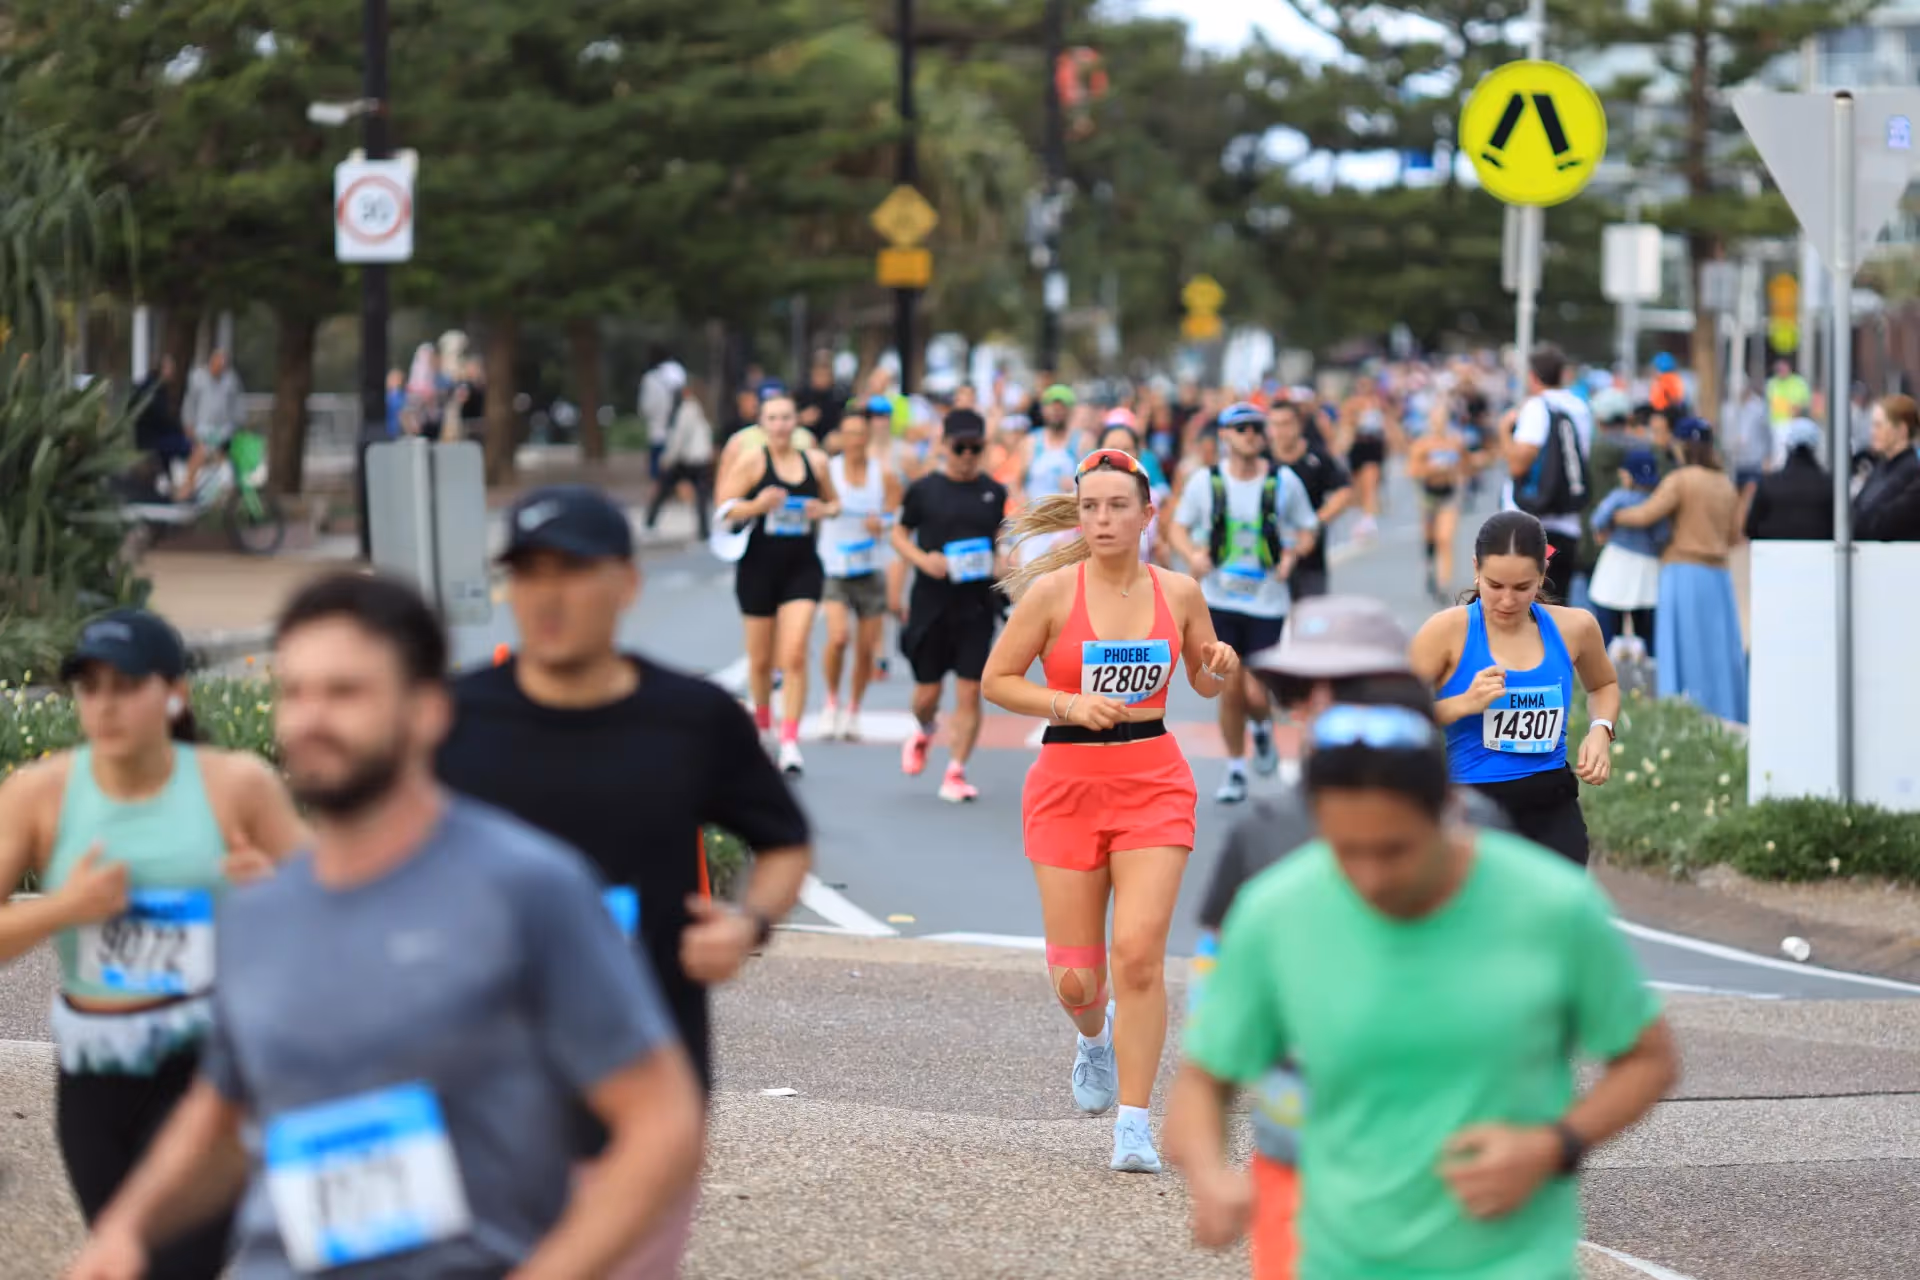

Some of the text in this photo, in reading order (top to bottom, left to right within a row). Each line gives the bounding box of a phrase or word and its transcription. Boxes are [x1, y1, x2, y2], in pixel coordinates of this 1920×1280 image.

[1104, 648, 1150, 663] PHOEBE
[1092, 665, 1162, 693] 12809
[1510, 693, 1545, 709] EMMA
[1493, 709, 1559, 740] 14307
